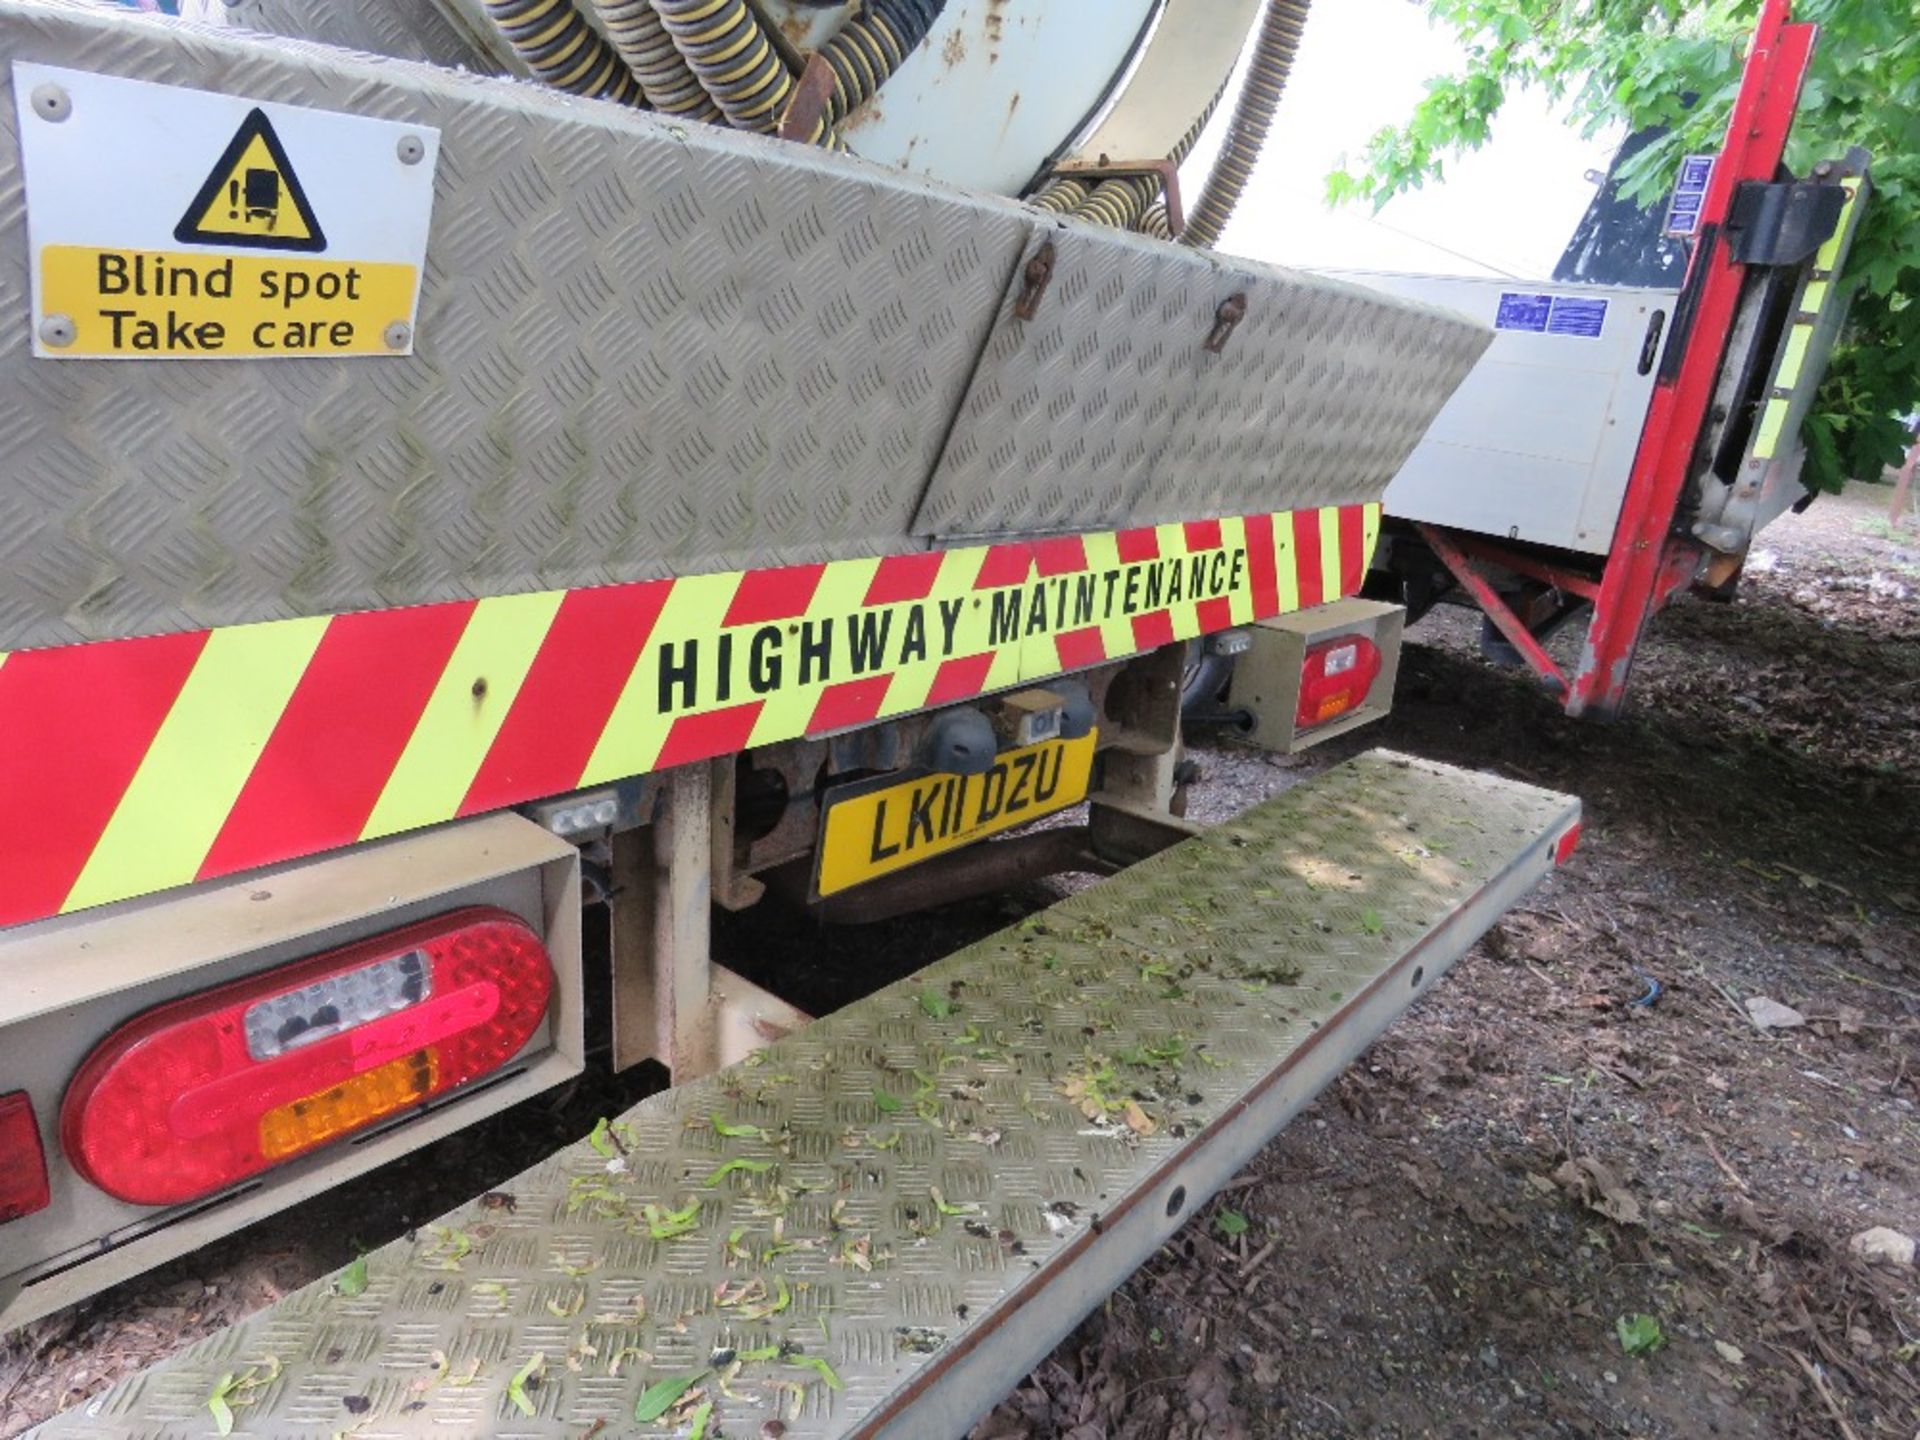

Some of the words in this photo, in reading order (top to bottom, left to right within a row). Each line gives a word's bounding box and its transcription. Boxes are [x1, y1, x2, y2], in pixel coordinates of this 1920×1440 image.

[98, 253, 233, 297] Blind
[260, 266, 361, 308] spot
[100, 309, 226, 351] Take
[252, 321, 355, 349] care
[657, 597, 963, 714] HIGHWAY
[988, 548, 1246, 646] MAINTENANCE
[870, 774, 968, 864] LK11
[977, 745, 1064, 825] DZU
